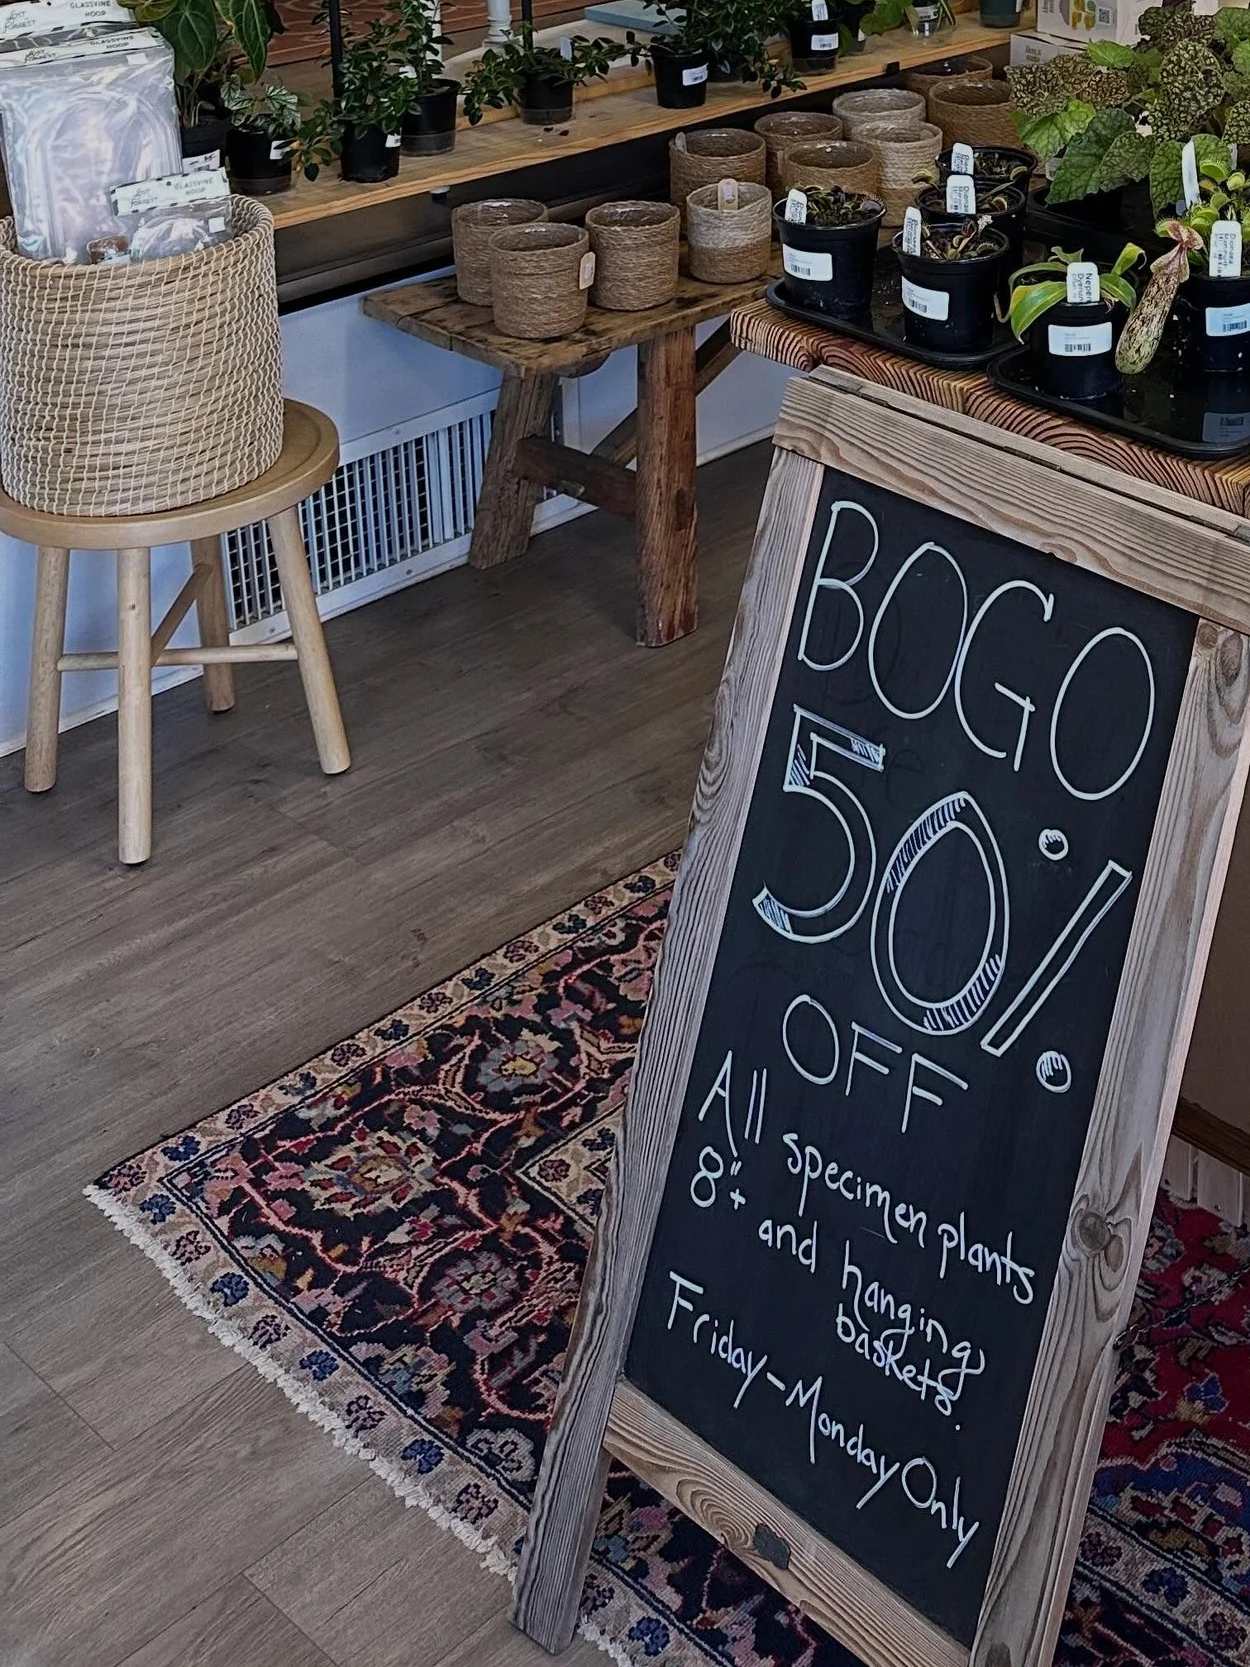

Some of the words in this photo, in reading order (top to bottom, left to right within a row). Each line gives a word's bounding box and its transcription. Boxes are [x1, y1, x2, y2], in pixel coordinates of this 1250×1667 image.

[70, 0, 111, 9] GLASSVINE
[85, 10, 107, 18] HOOP
[89, 35, 134, 46] GLASSVINE
[106, 41, 130, 50] HOOP
[174, 177, 213, 189] GLASSVINE
[797, 500, 1155, 800] BOGO
[752, 704, 1132, 1093] 50%
[783, 994, 968, 1134] OFF
[699, 1050, 767, 1157] All
[783, 1133, 927, 1247] specimen
[938, 1212, 1034, 1305] plants
[758, 1220, 818, 1273] and
[842, 1239, 986, 1401] hanging
[901, 1455, 980, 1569] Only
